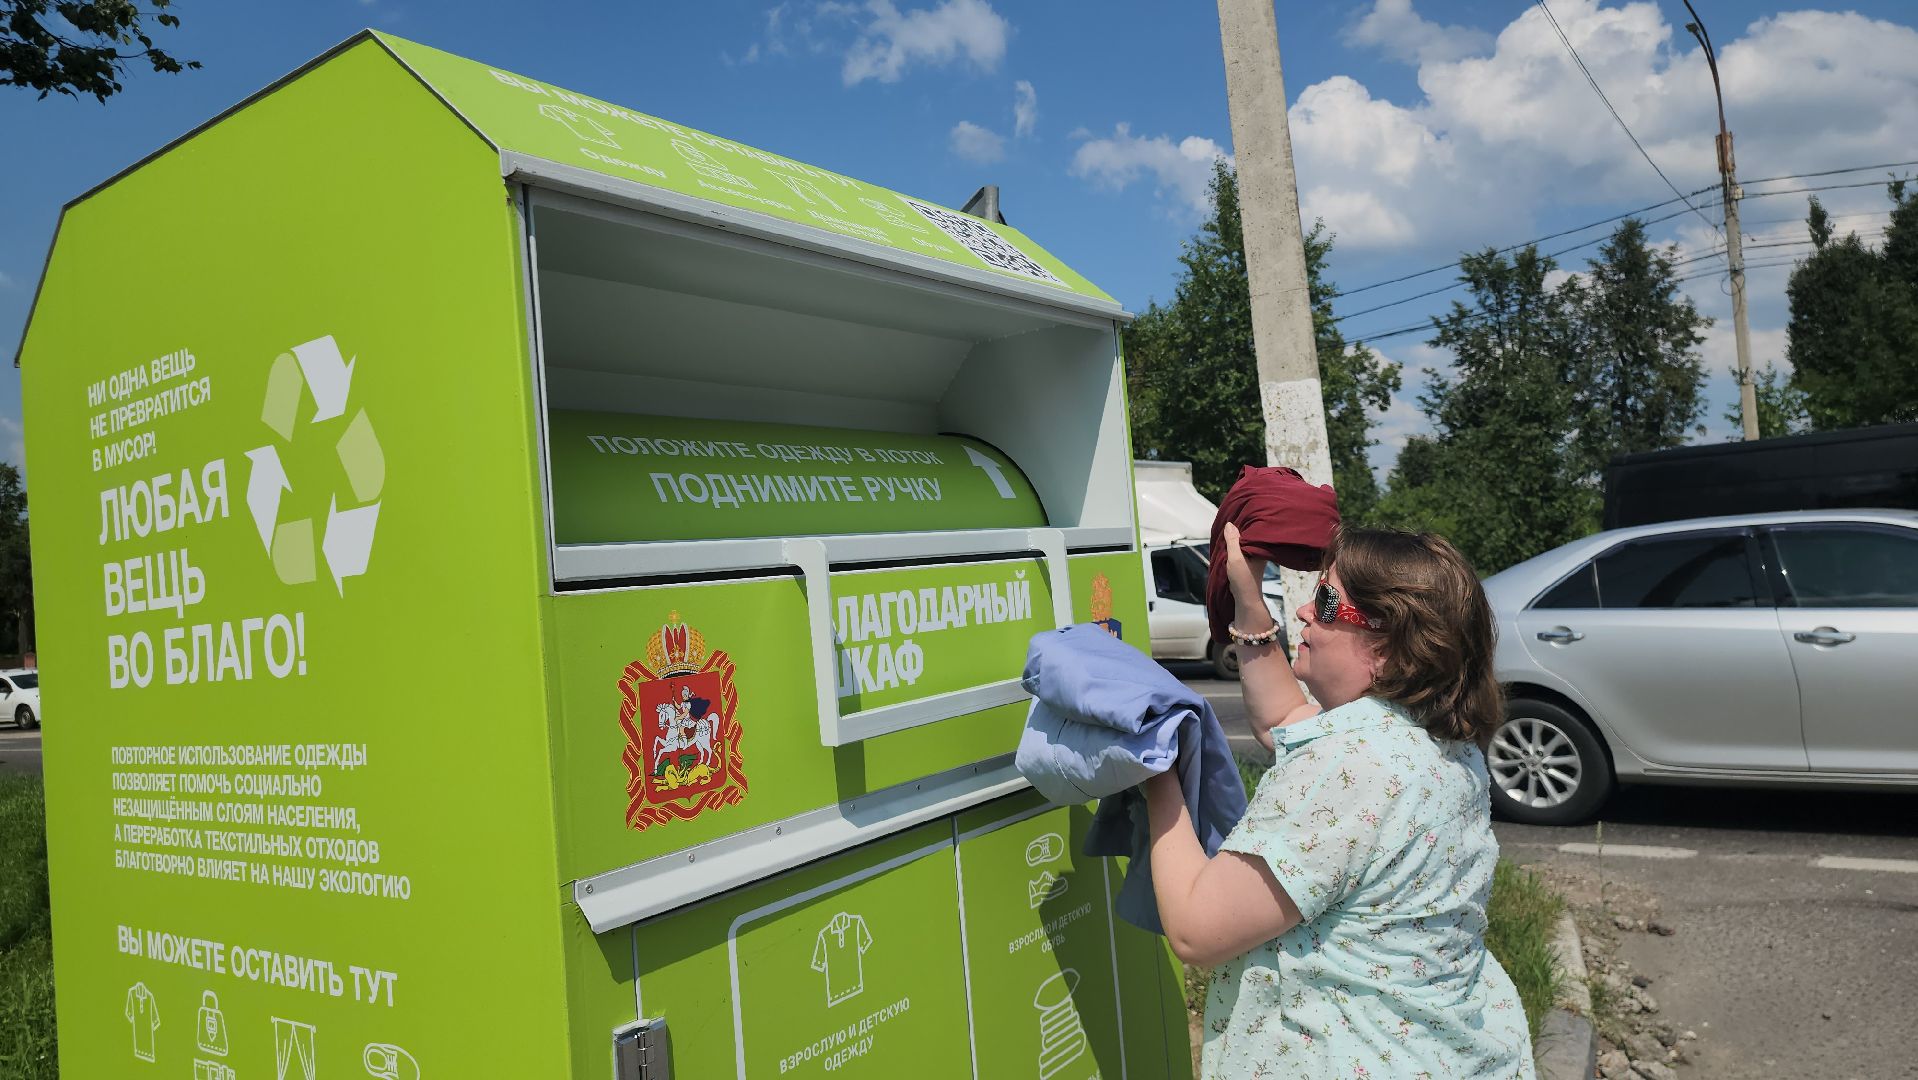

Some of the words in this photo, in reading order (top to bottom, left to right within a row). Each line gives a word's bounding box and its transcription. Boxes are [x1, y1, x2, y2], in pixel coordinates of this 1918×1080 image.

[488, 70, 551, 97] ВЫ
[551, 89, 691, 139] МОЖЕТЕ
[691, 132, 820, 177] ОСТАВИТЬ
[817, 170, 862, 191] ТУТ
[579, 147, 667, 179] Одежду
[88, 376, 107, 407] НИ
[109, 365, 149, 401] ОДНА
[151, 348, 196, 385] ВЕЩЬ
[90, 416, 108, 439] НЕ
[110, 376, 211, 432] ПРЕВРАТИТСЯ
[92, 449, 102, 472] В
[104, 431, 157, 470] МУСОР!
[586, 434, 756, 458] ПОЛОЖИТЕ
[756, 443, 853, 464] ОДЕЖДУ
[853, 448, 877, 462] В
[876, 448, 944, 465] ЛОТОК
[100, 458, 229, 545] ЛЮБАЯ
[649, 472, 863, 508] ПОДНИМИТЕ
[861, 476, 942, 501] РУЧКУ
[104, 548, 205, 619] ВЕЩЬ
[832, 569, 1032, 645] ЛАГОДАРНЫЙ
[108, 631, 154, 689] ВО
[165, 612, 307, 685] БЛАГО!
[112, 746, 175, 765] ПОВТОРНОЕ
[179, 744, 291, 766] ИСПОЛЬЗОВАНИЕ
[294, 743, 367, 770] ОДЕЖДЫ
[112, 772, 176, 791] ПОЗВОЛЯЕТ
[179, 773, 231, 795] ПОМОЧЬ
[234, 774, 321, 798] СОЦИАЛЬНО
[113, 796, 213, 822] НЕЗАЩИЩЁННЫМ
[216, 802, 263, 825] СЛОЯМ
[267, 804, 360, 833] НАСЕЛЕНИЯ,
[114, 824, 122, 841] А
[123, 824, 202, 849] ПЕРЕРАБОТКА
[204, 831, 302, 858] ТЕКСТИЛЬНЫХ
[305, 836, 379, 866] ОТХОДОВ
[115, 849, 194, 876] БЛАГОТВОРНО
[198, 857, 247, 882] ВЛИЯЕТ
[250, 863, 269, 884] НА
[273, 864, 315, 890] НАШУ
[319, 868, 411, 900] ЭКОЛОГИЮ
[1008, 923, 1052, 954] ВЗРОСЛУЮ
[1052, 920, 1057, 931] И
[1059, 902, 1091, 930] ДЕТСКУЮ
[1041, 933, 1066, 953] ОБУВЬ
[117, 924, 143, 956] ВЫ
[147, 930, 226, 974] МОЖЕТЕ
[231, 945, 343, 998] ОСТАВИТЬ
[349, 965, 397, 1007] ТУТ
[779, 1029, 846, 1074] ВЗРОСЛУЮ
[848, 1023, 856, 1039] И
[859, 997, 910, 1036] ДЕТСКУЮ
[824, 1034, 874, 1071] ОДЕЖДУ
